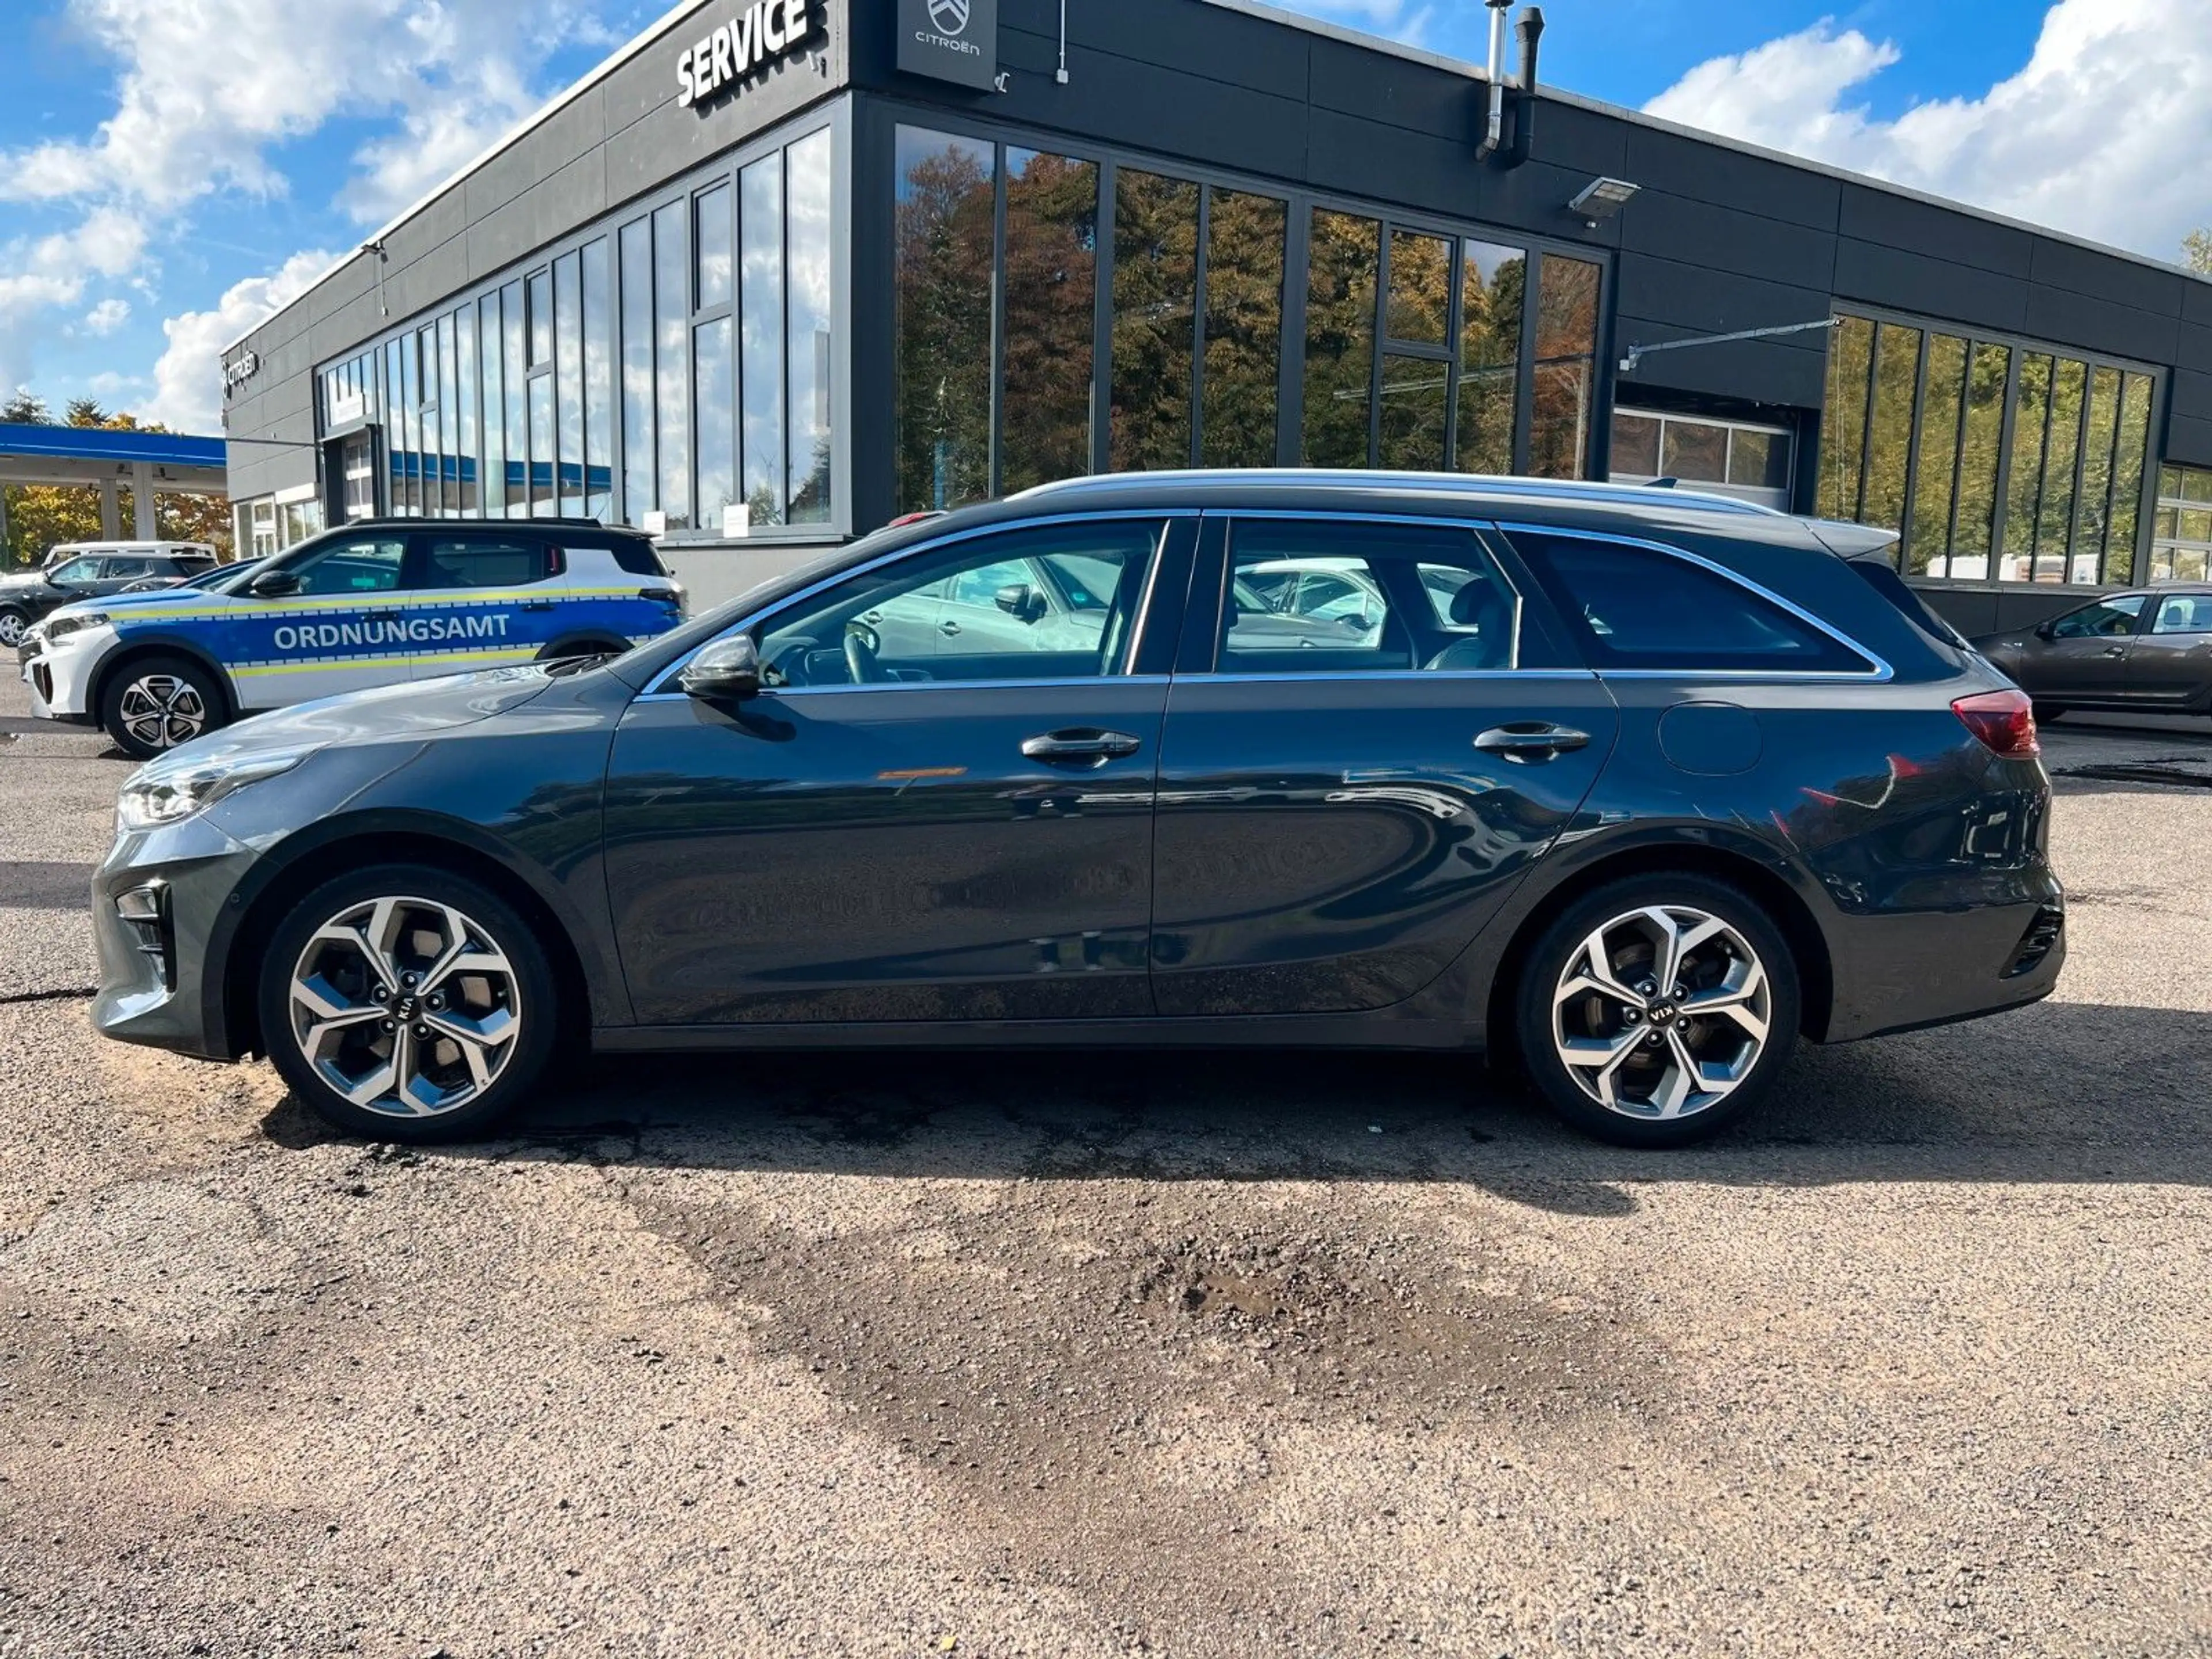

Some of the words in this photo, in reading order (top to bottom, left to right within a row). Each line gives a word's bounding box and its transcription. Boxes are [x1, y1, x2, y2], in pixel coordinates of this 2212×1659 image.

[677, 0, 806, 108] SERVICE
[274, 614, 510, 650] ORDNUNGSAMT
[397, 997, 414, 1019] KIA
[1650, 1005, 1674, 1021] KIA
